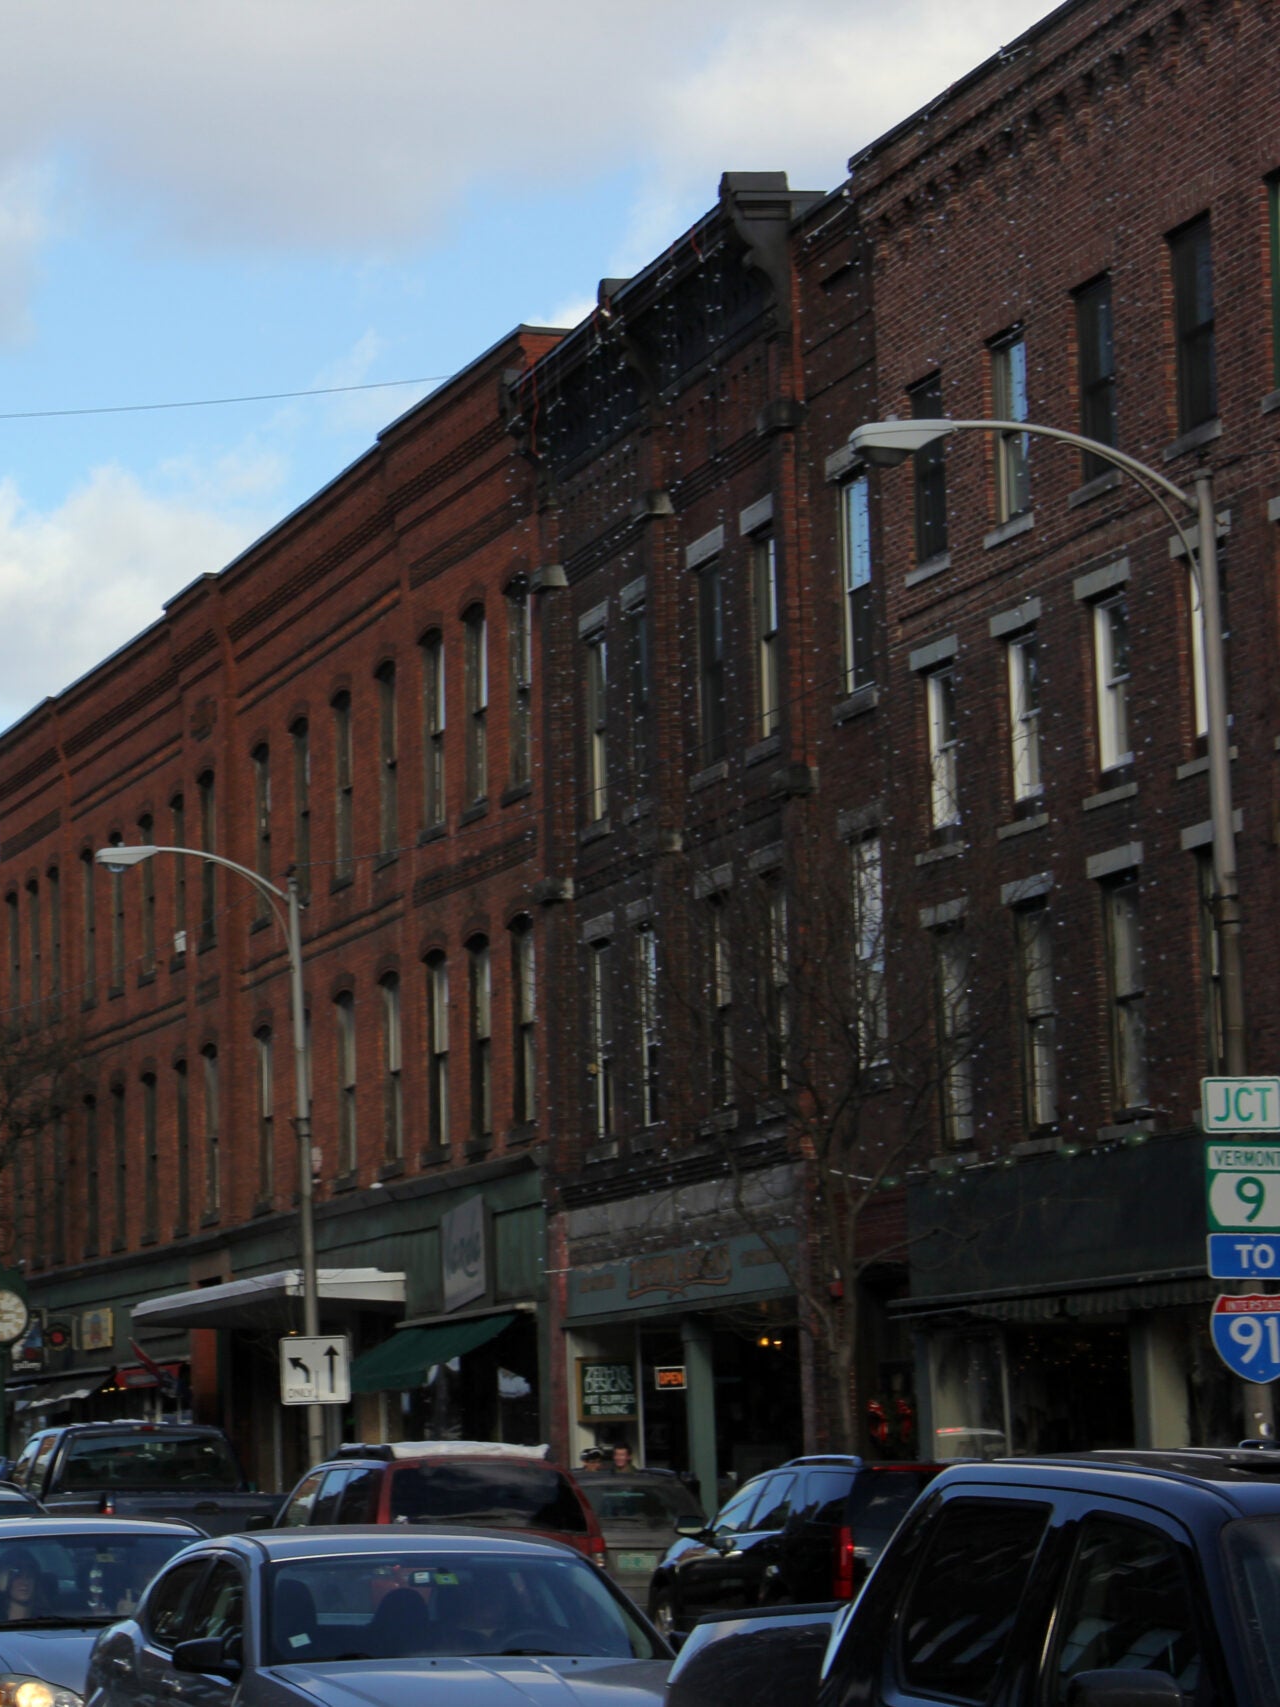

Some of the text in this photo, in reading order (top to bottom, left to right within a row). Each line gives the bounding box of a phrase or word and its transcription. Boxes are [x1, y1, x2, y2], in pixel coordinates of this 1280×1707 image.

[1213, 1087, 1272, 1122] JCT
[1214, 1150, 1280, 1167] VERMONT
[1235, 1176, 1266, 1222] 9
[1234, 1244, 1275, 1269] TO
[1225, 1300, 1280, 1312] INTERSTAT
[1229, 1316, 1280, 1363] 91
[584, 1378, 633, 1393] DESIGNS
[657, 1371, 684, 1385] OPEN
[288, 1388, 314, 1399] ONLY
